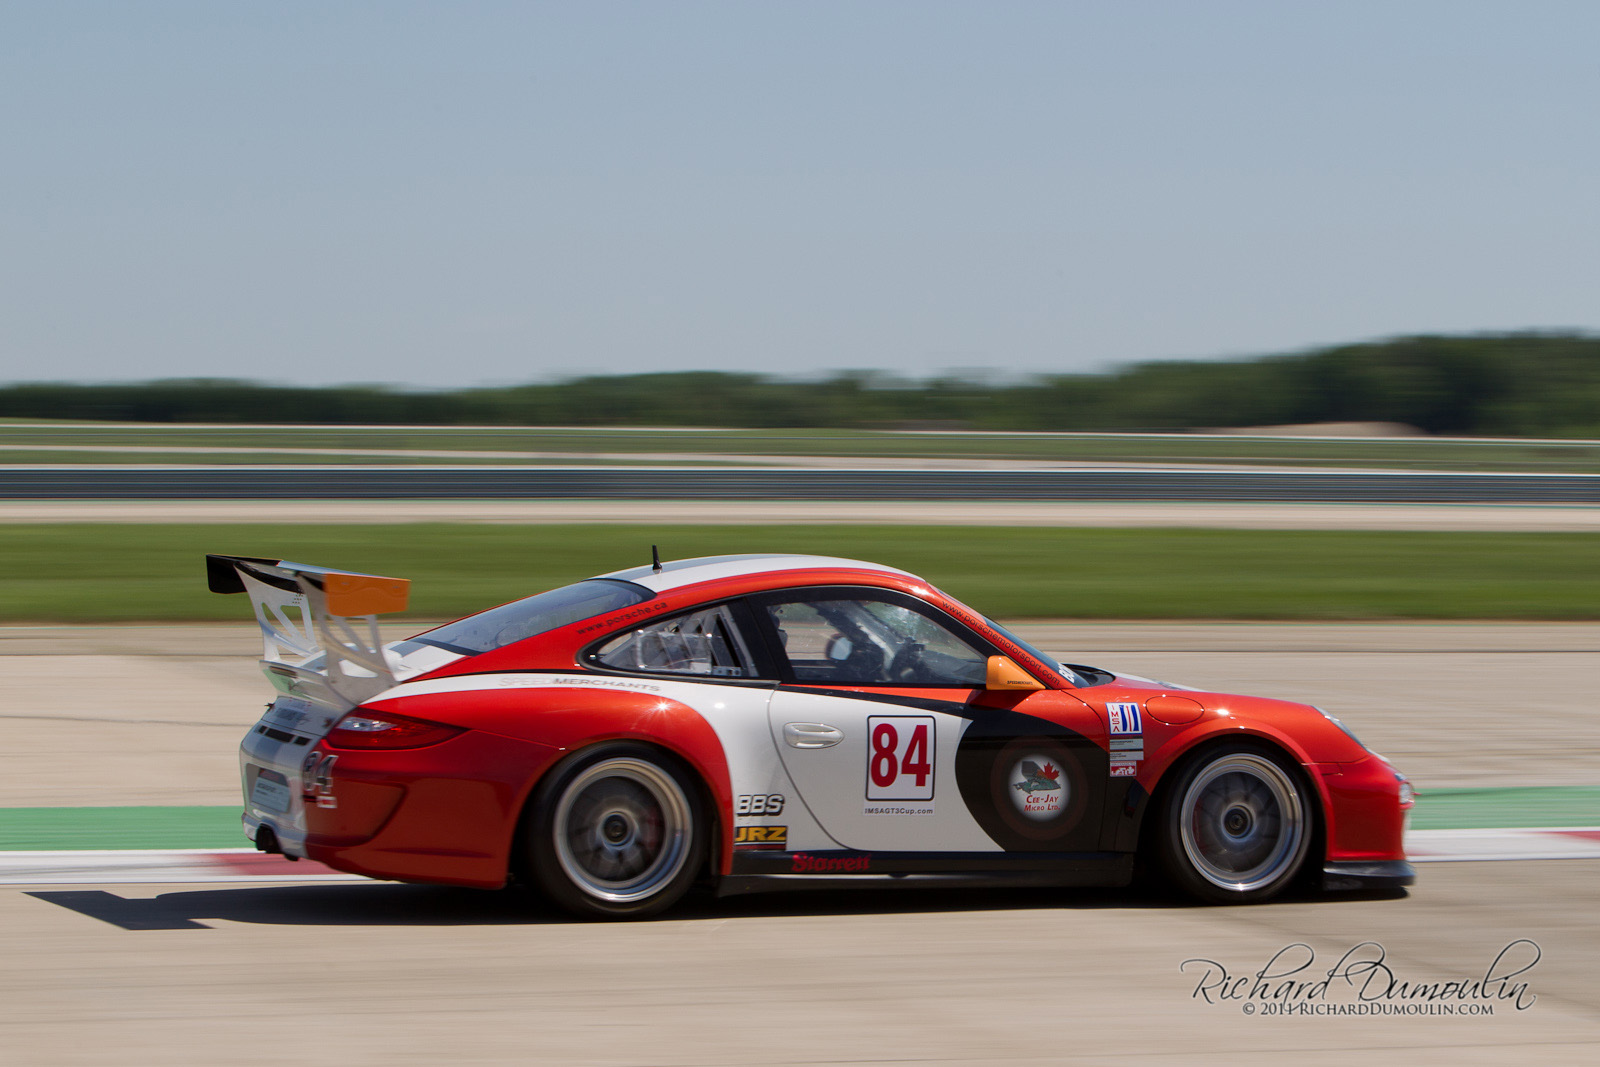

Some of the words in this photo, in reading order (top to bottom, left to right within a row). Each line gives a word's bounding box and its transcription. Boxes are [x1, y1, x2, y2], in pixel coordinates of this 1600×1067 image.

[576, 602, 668, 634] www.porsche.ca
[941, 600, 1061, 687] www.porschemotorsport.com
[871, 723, 931, 787] 84
[302, 751, 339, 794] 84
[736, 794, 785, 816] BBS
[865, 807, 933, 816] IMSAGT3Cup.com
[735, 827, 787, 842] JRZ
[792, 853, 871, 872] Starrett
